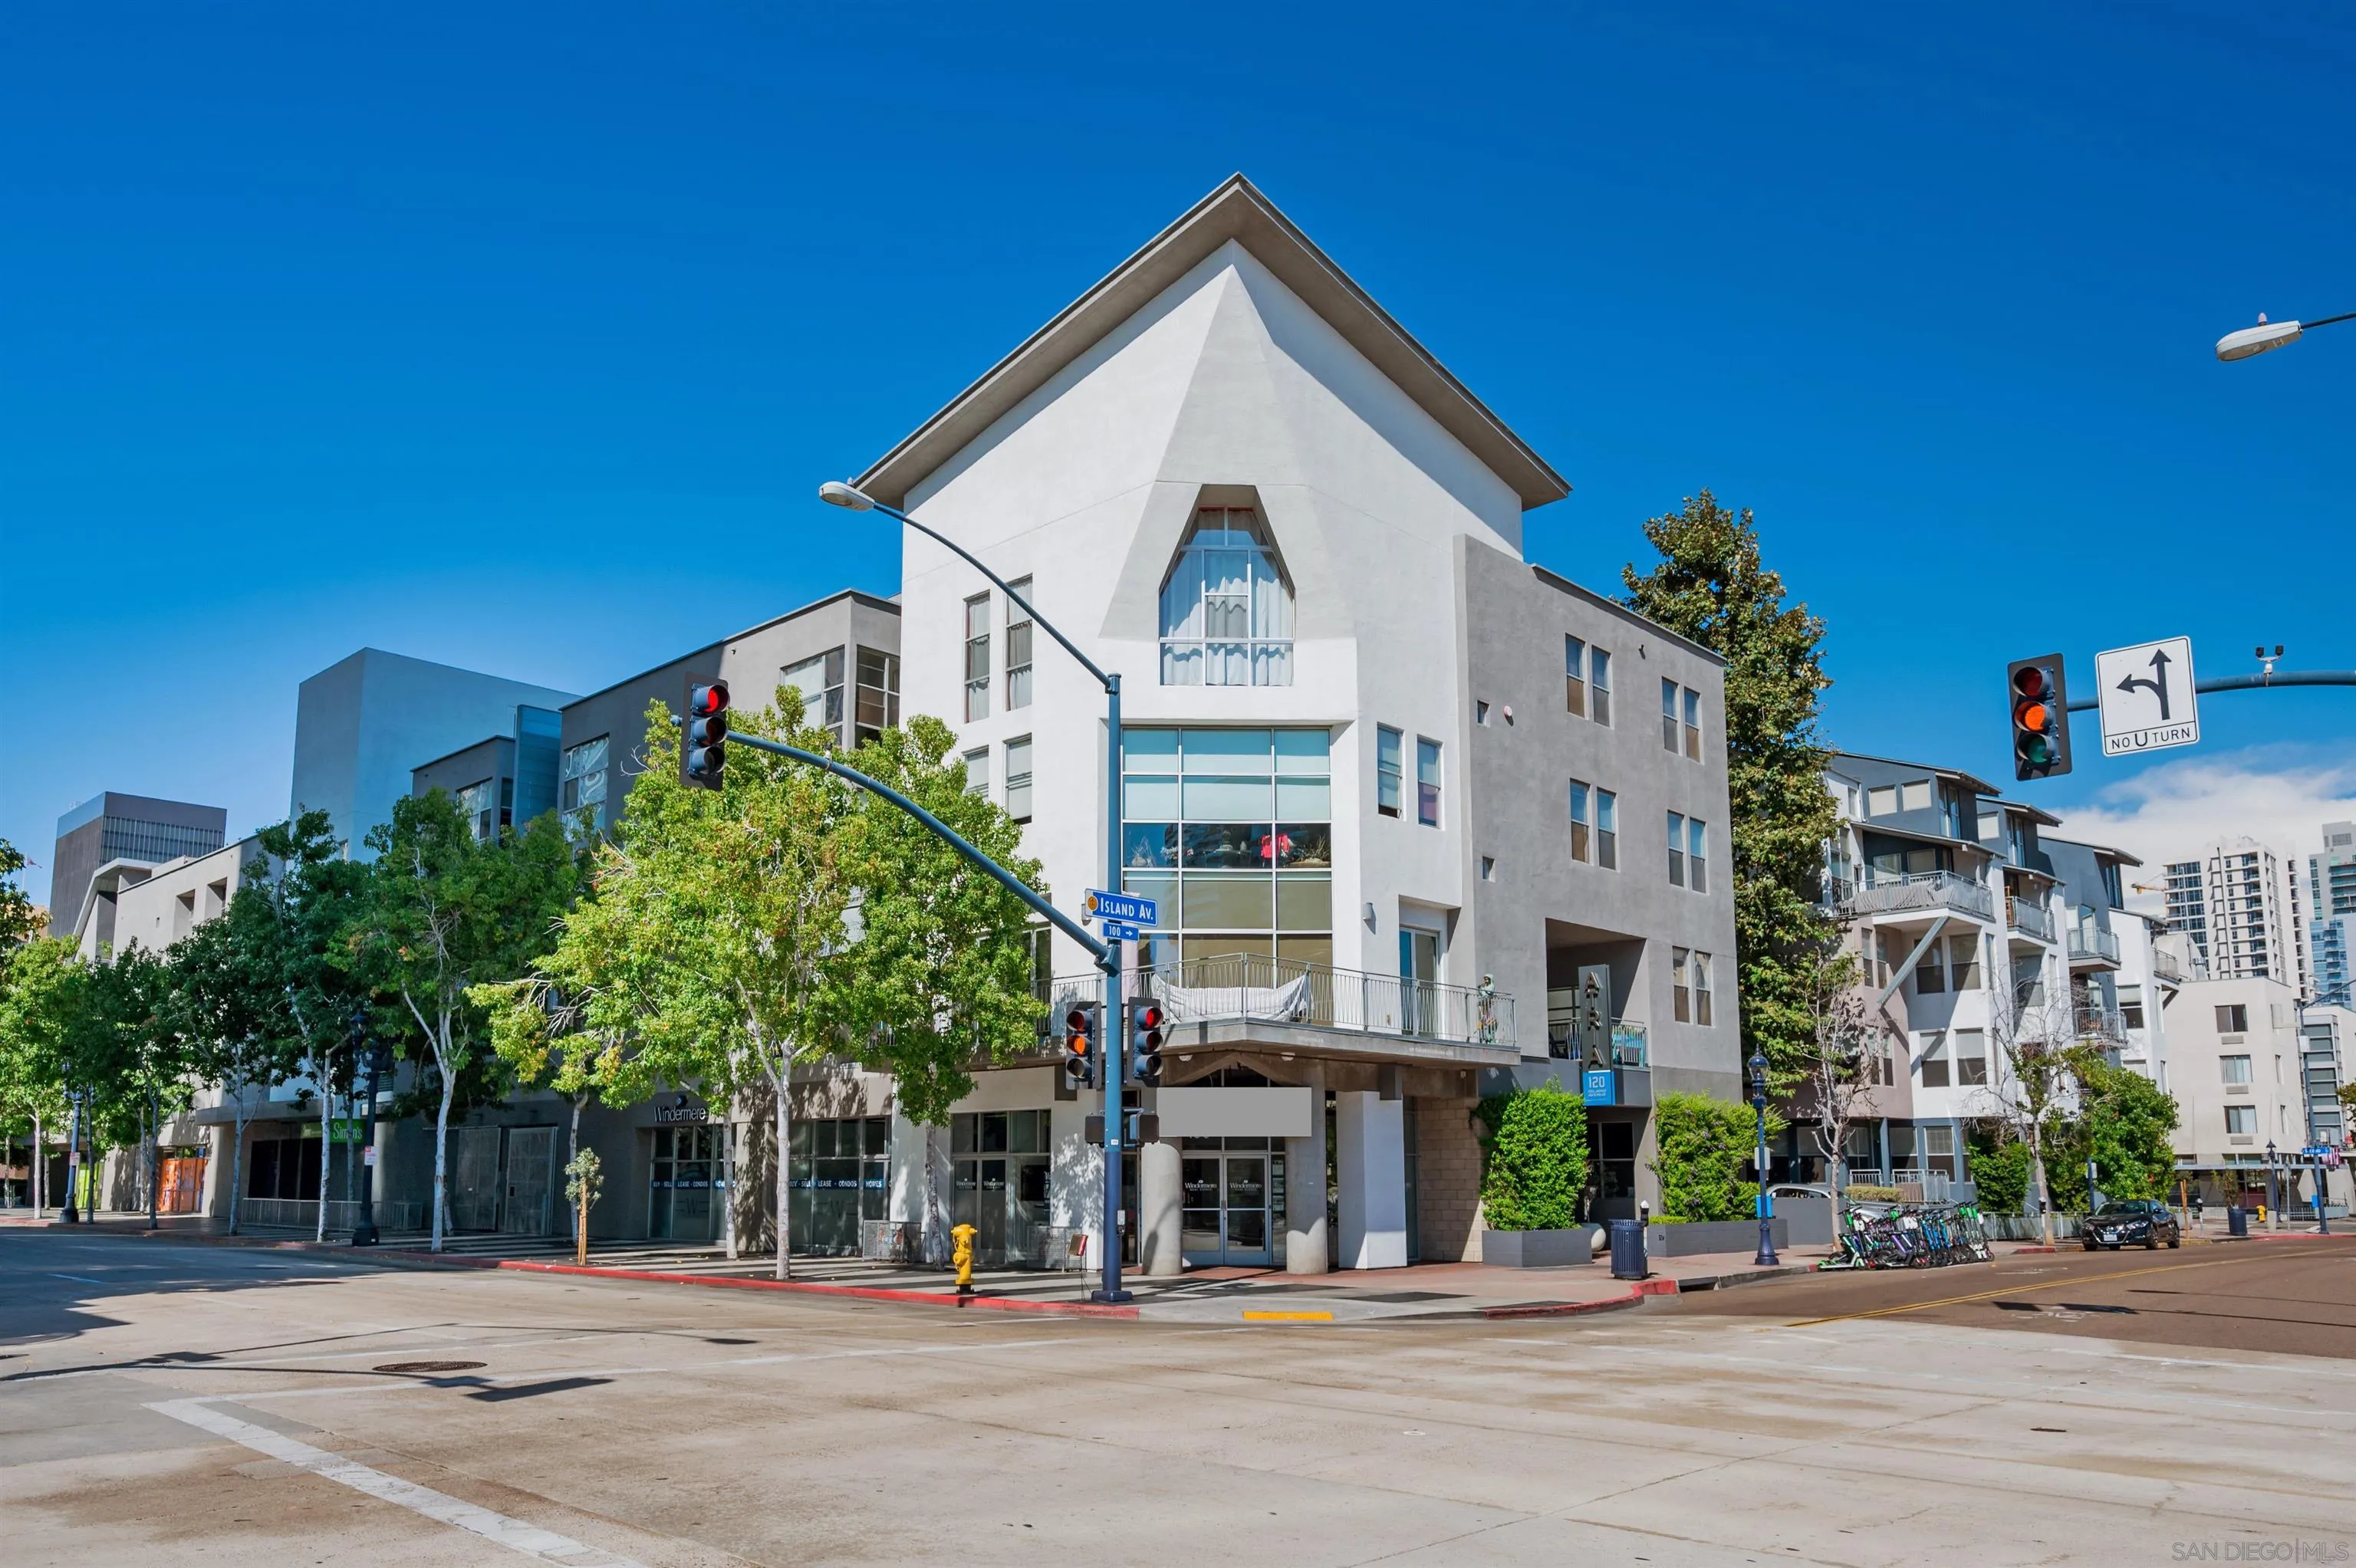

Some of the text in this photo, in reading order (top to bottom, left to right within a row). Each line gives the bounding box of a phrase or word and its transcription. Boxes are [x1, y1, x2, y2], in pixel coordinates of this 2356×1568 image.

[2111, 727, 2190, 749] NO U TURN
[1108, 925, 1121, 937] 100
[1588, 1076, 1605, 1089] 120
[653, 1106, 706, 1123] Windermere
[333, 1122, 363, 1139] Simn's
